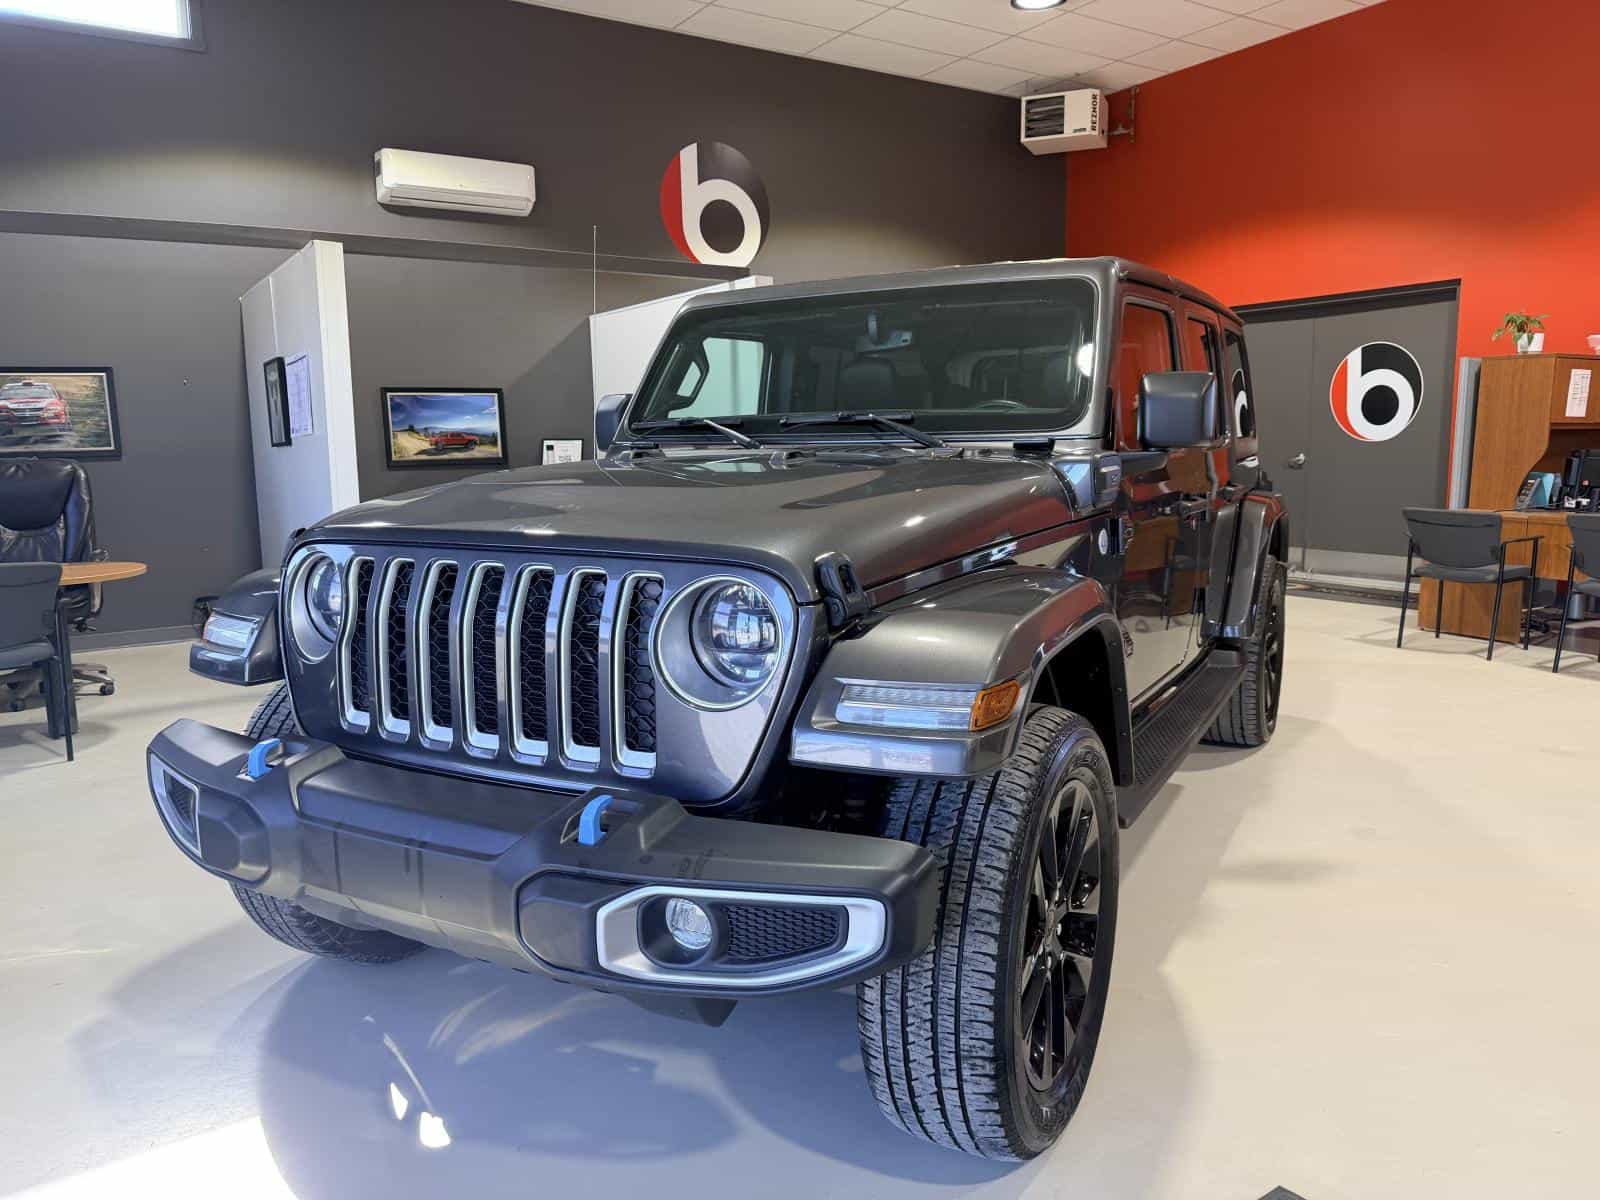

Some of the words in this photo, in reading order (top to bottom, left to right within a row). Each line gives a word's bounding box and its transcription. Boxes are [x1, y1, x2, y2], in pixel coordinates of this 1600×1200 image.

[1090, 93, 1098, 131] REZNOR
[679, 141, 762, 267] b
[1344, 345, 1415, 441] b
